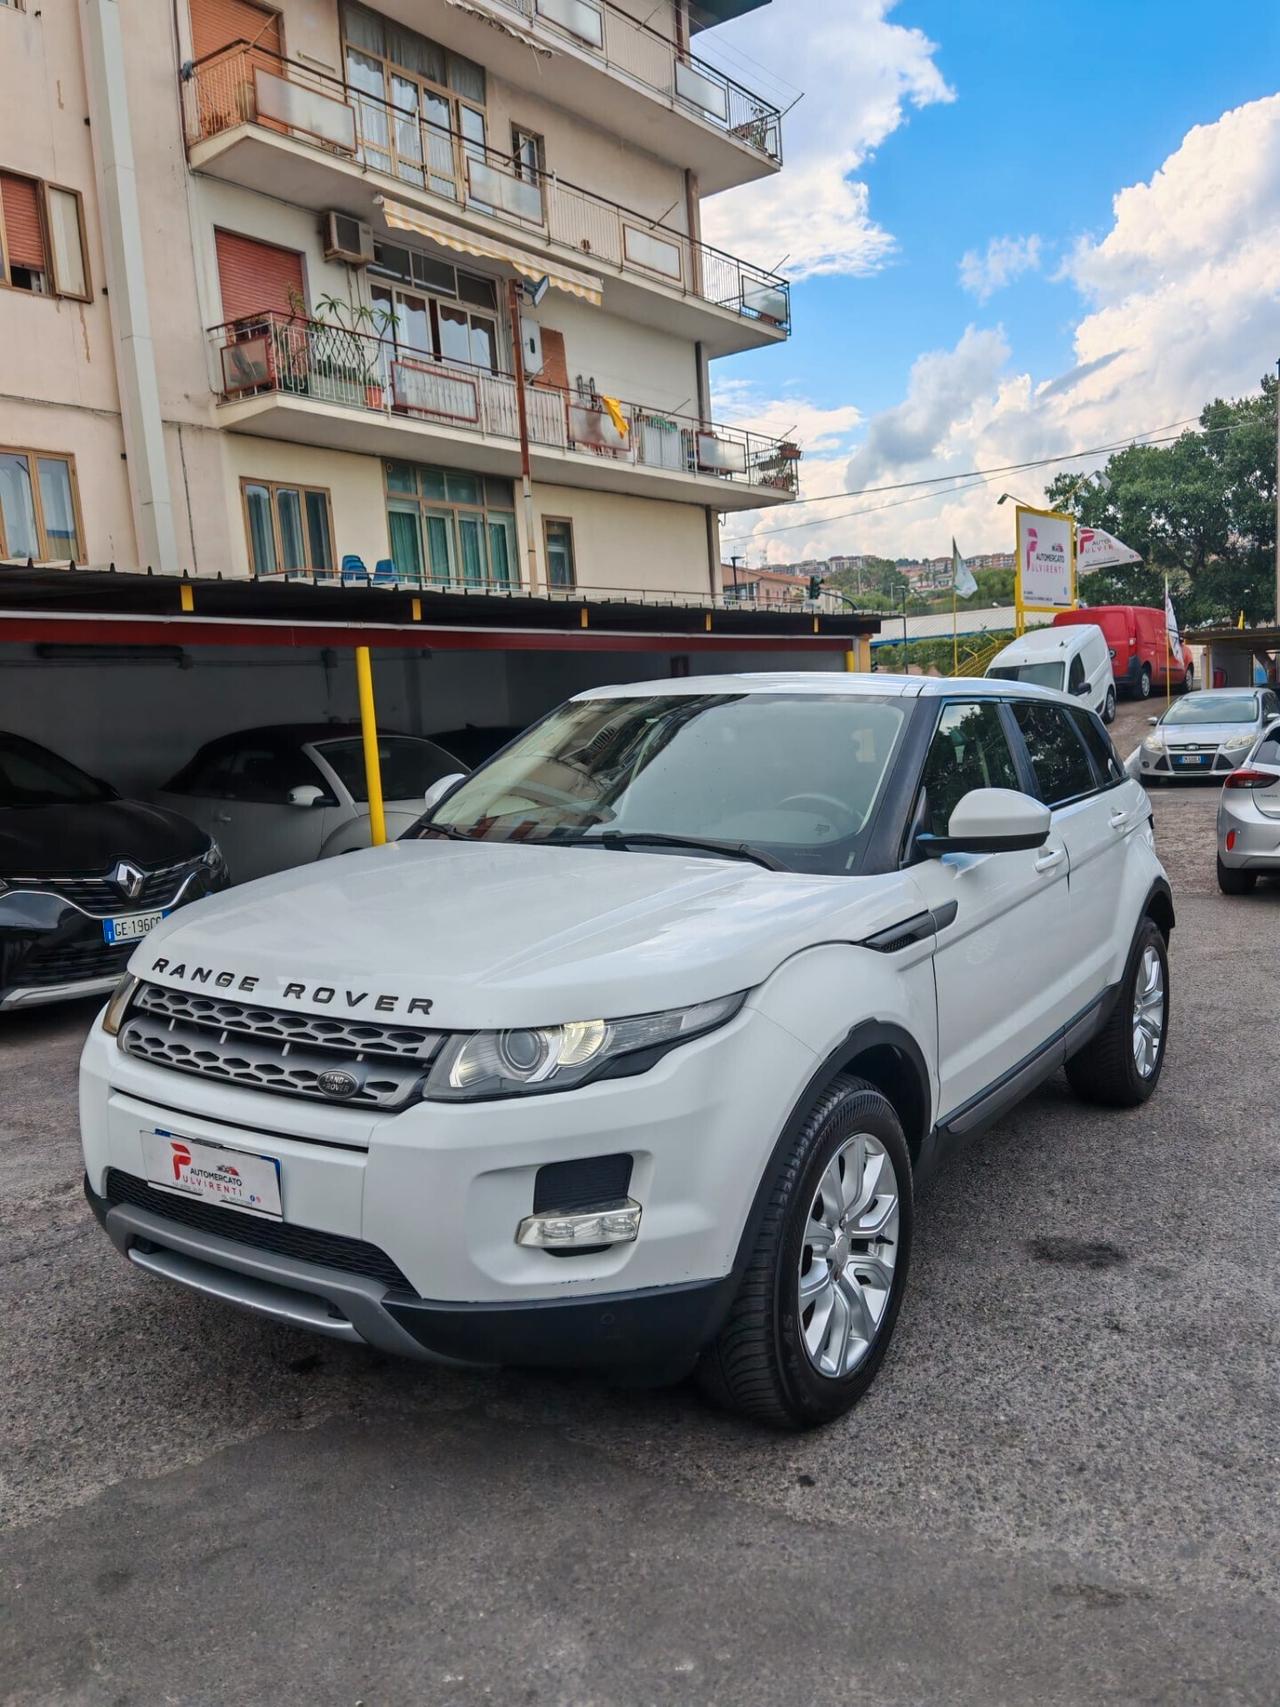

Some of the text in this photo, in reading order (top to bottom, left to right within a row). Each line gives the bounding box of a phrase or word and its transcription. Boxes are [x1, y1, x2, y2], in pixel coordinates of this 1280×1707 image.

[151, 957, 434, 1015] RANGE ROVER
[190, 1167, 242, 1187] AUTOMERCATO
